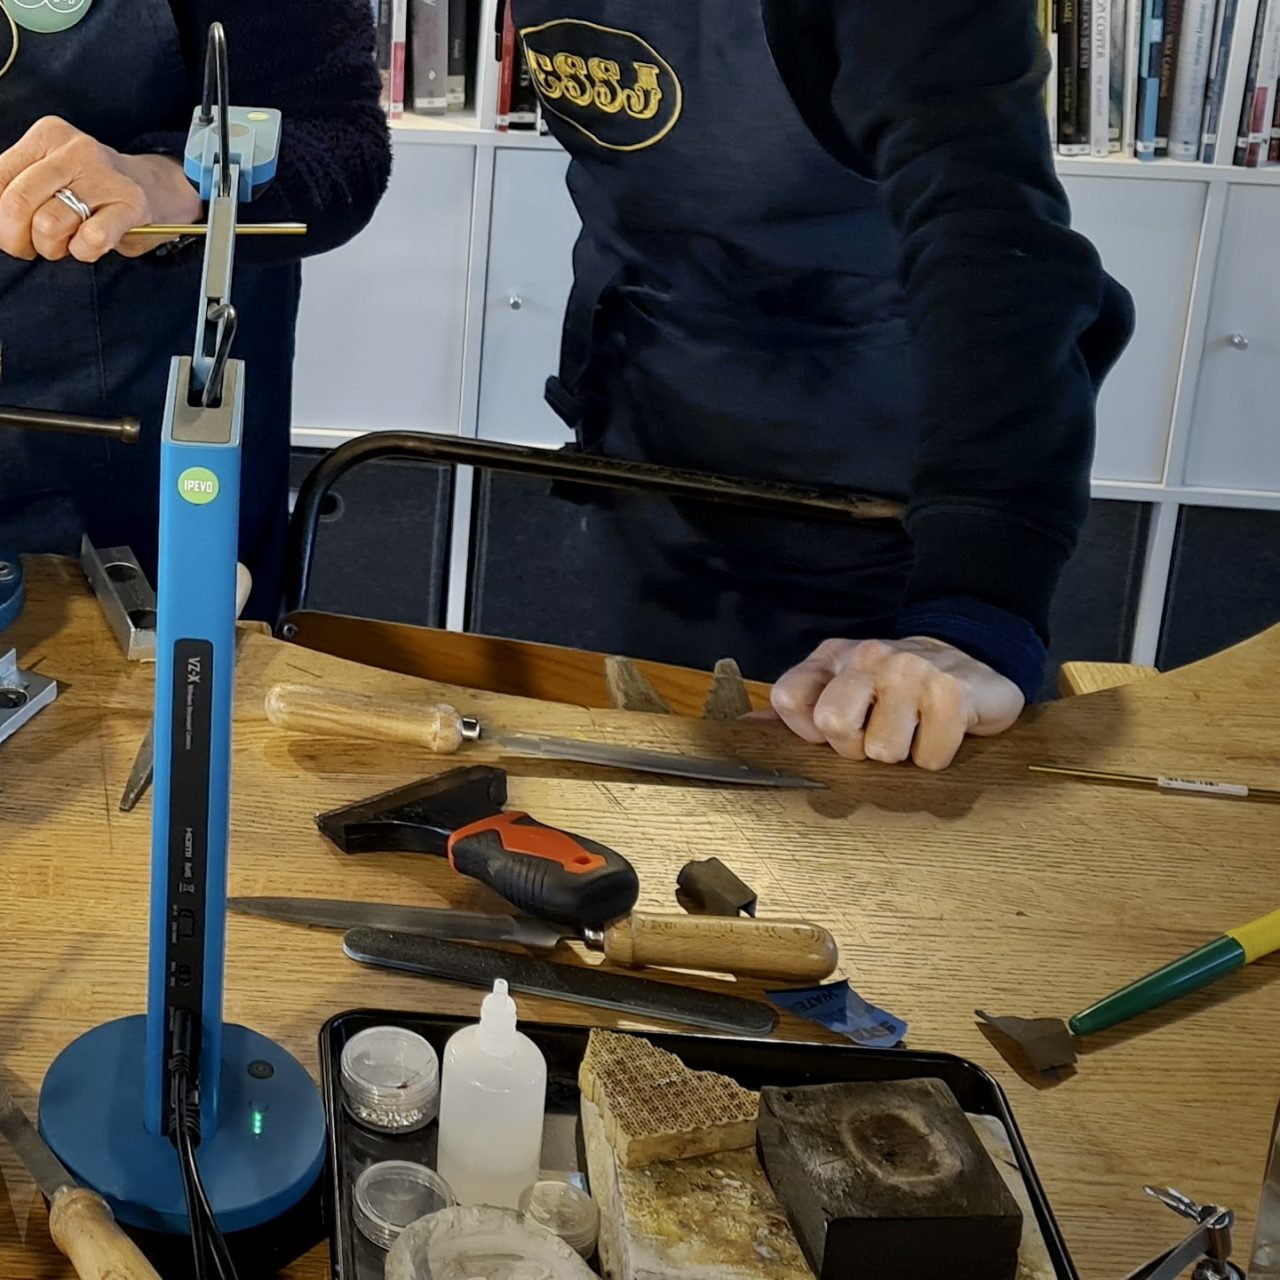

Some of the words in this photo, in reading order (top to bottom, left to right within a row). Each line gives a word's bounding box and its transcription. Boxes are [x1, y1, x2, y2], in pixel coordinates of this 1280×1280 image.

[1096, 16, 1107, 60] COPPER
[183, 479, 213, 494] IPEVO
[187, 656, 201, 683] VZ-X
